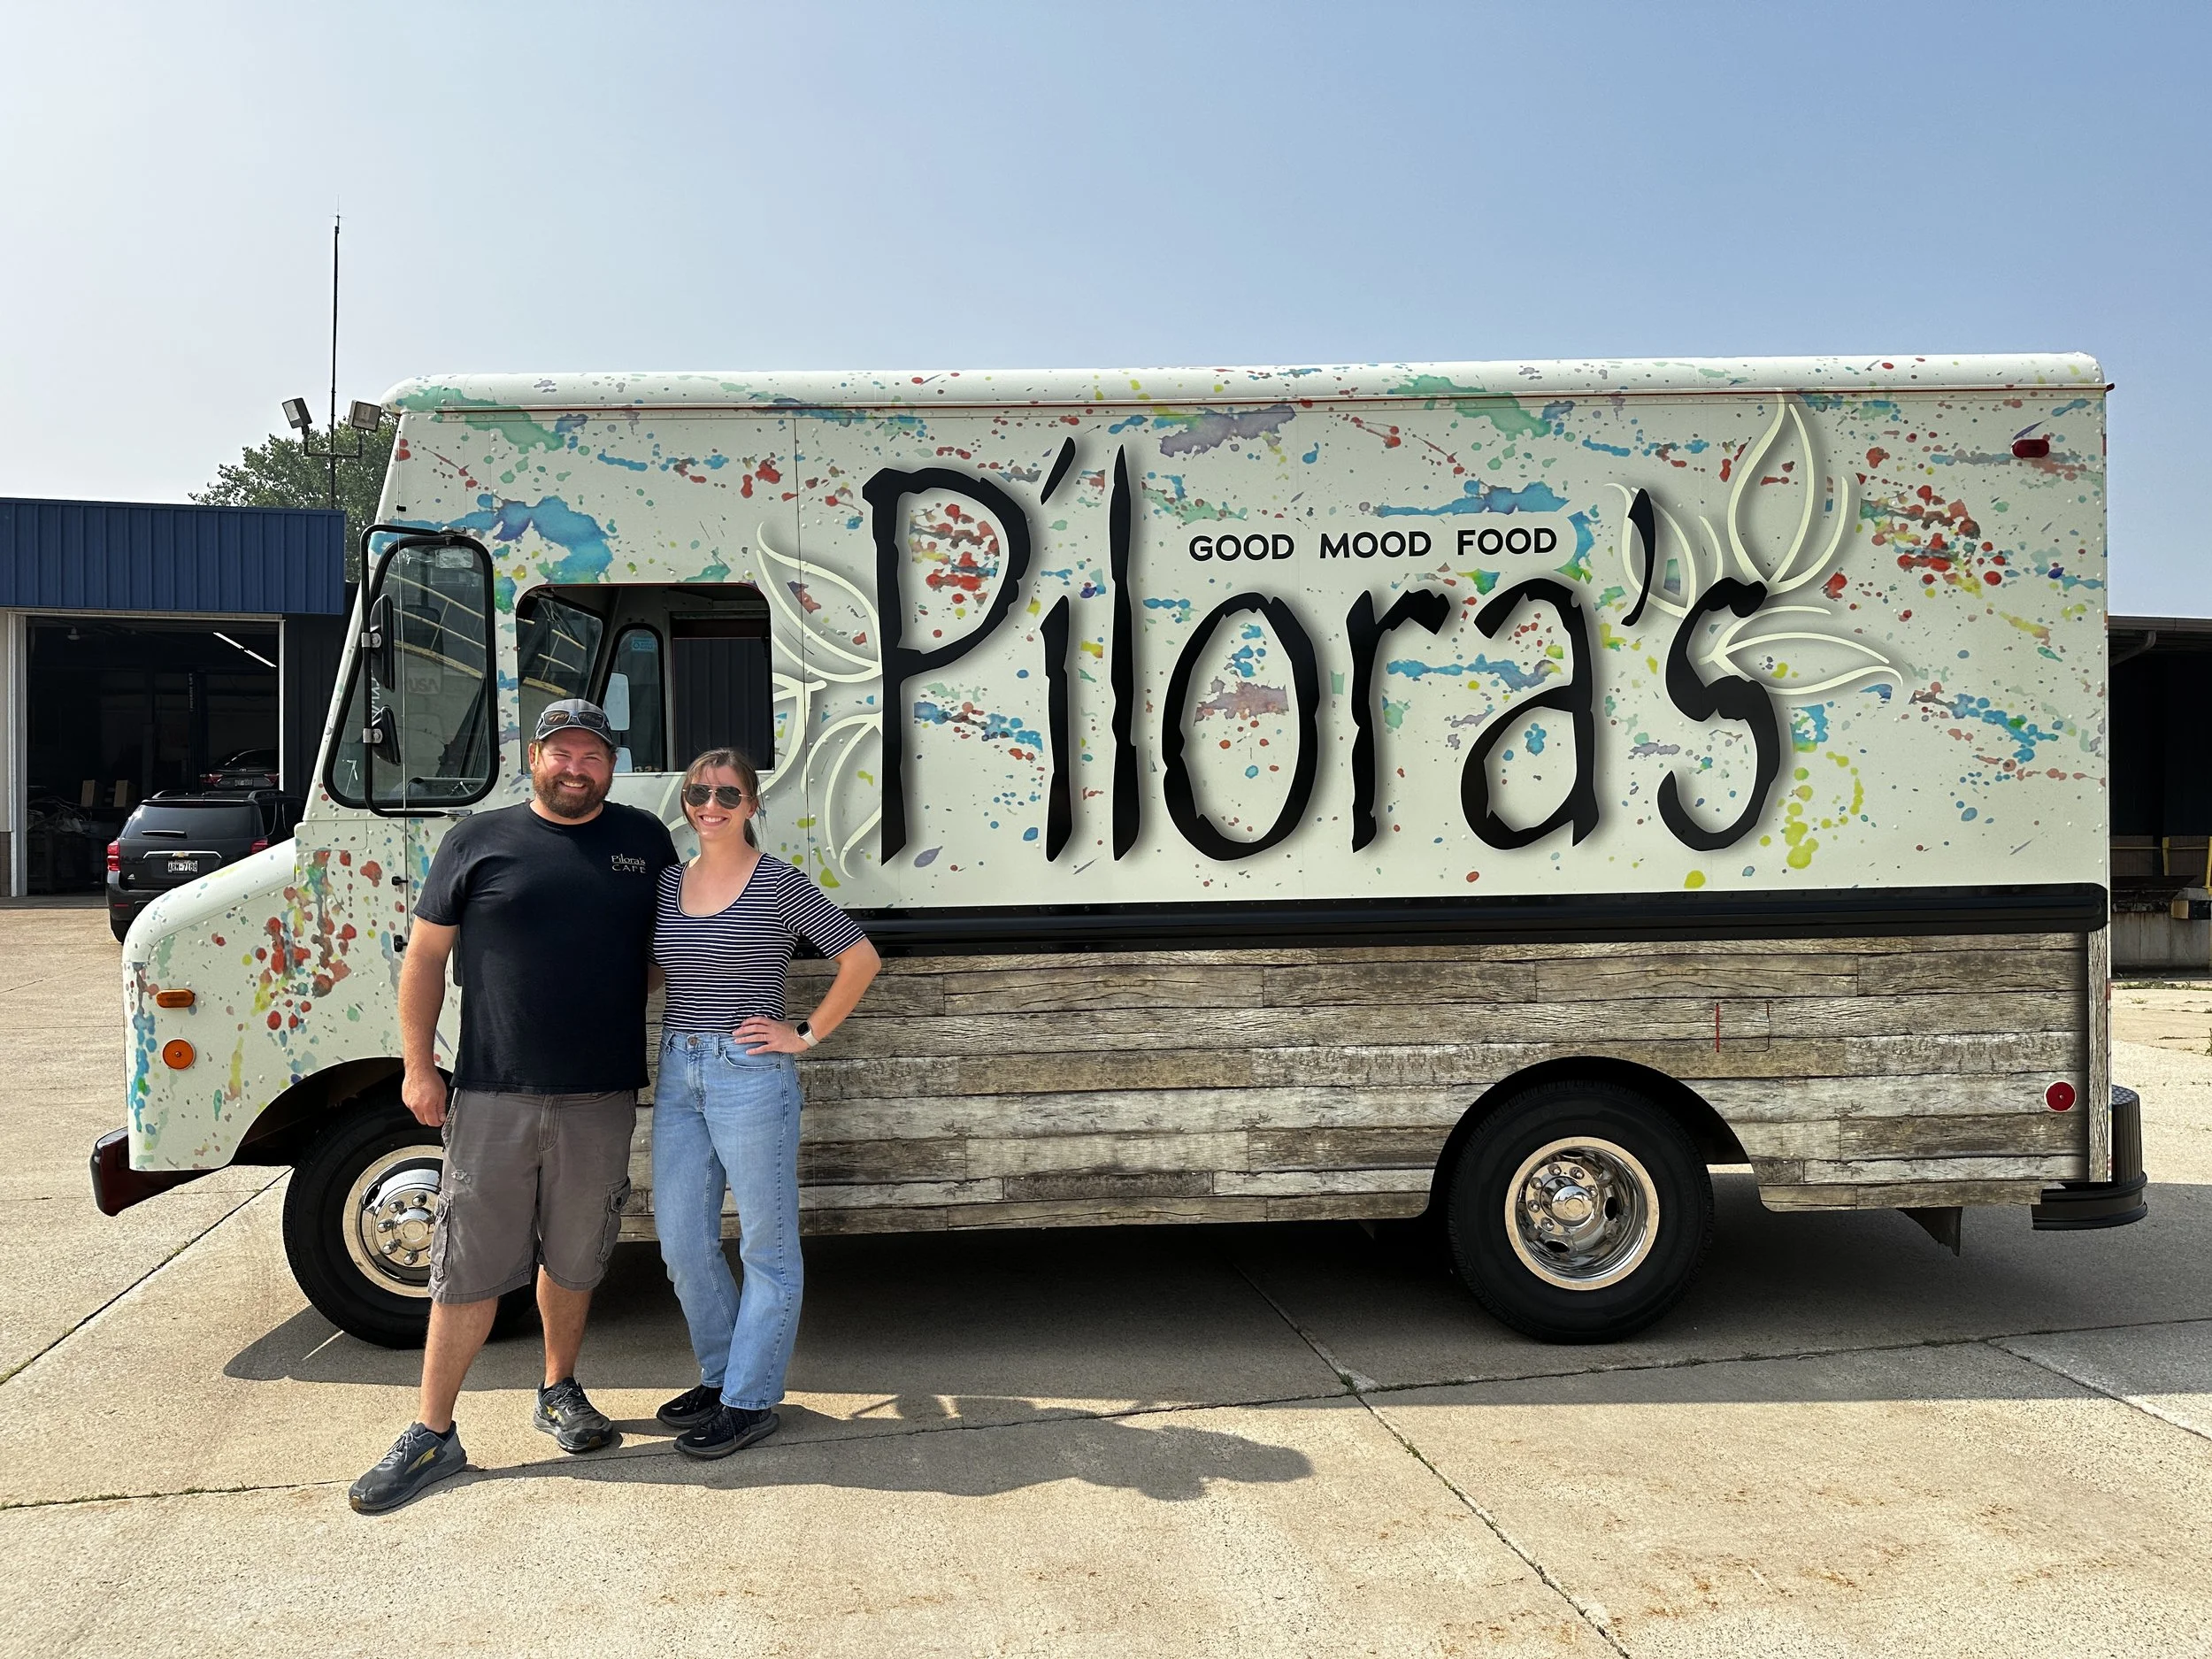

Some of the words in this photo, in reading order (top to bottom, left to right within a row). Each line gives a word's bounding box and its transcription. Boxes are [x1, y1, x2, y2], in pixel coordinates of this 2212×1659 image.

[1189, 532, 1294, 562] GOOD
[1319, 531, 1432, 559] MOOD
[1457, 527, 1557, 556] FOOD
[408, 678, 439, 693] USA
[611, 853, 646, 864] Pilora's
[611, 864, 647, 873] CAFE
